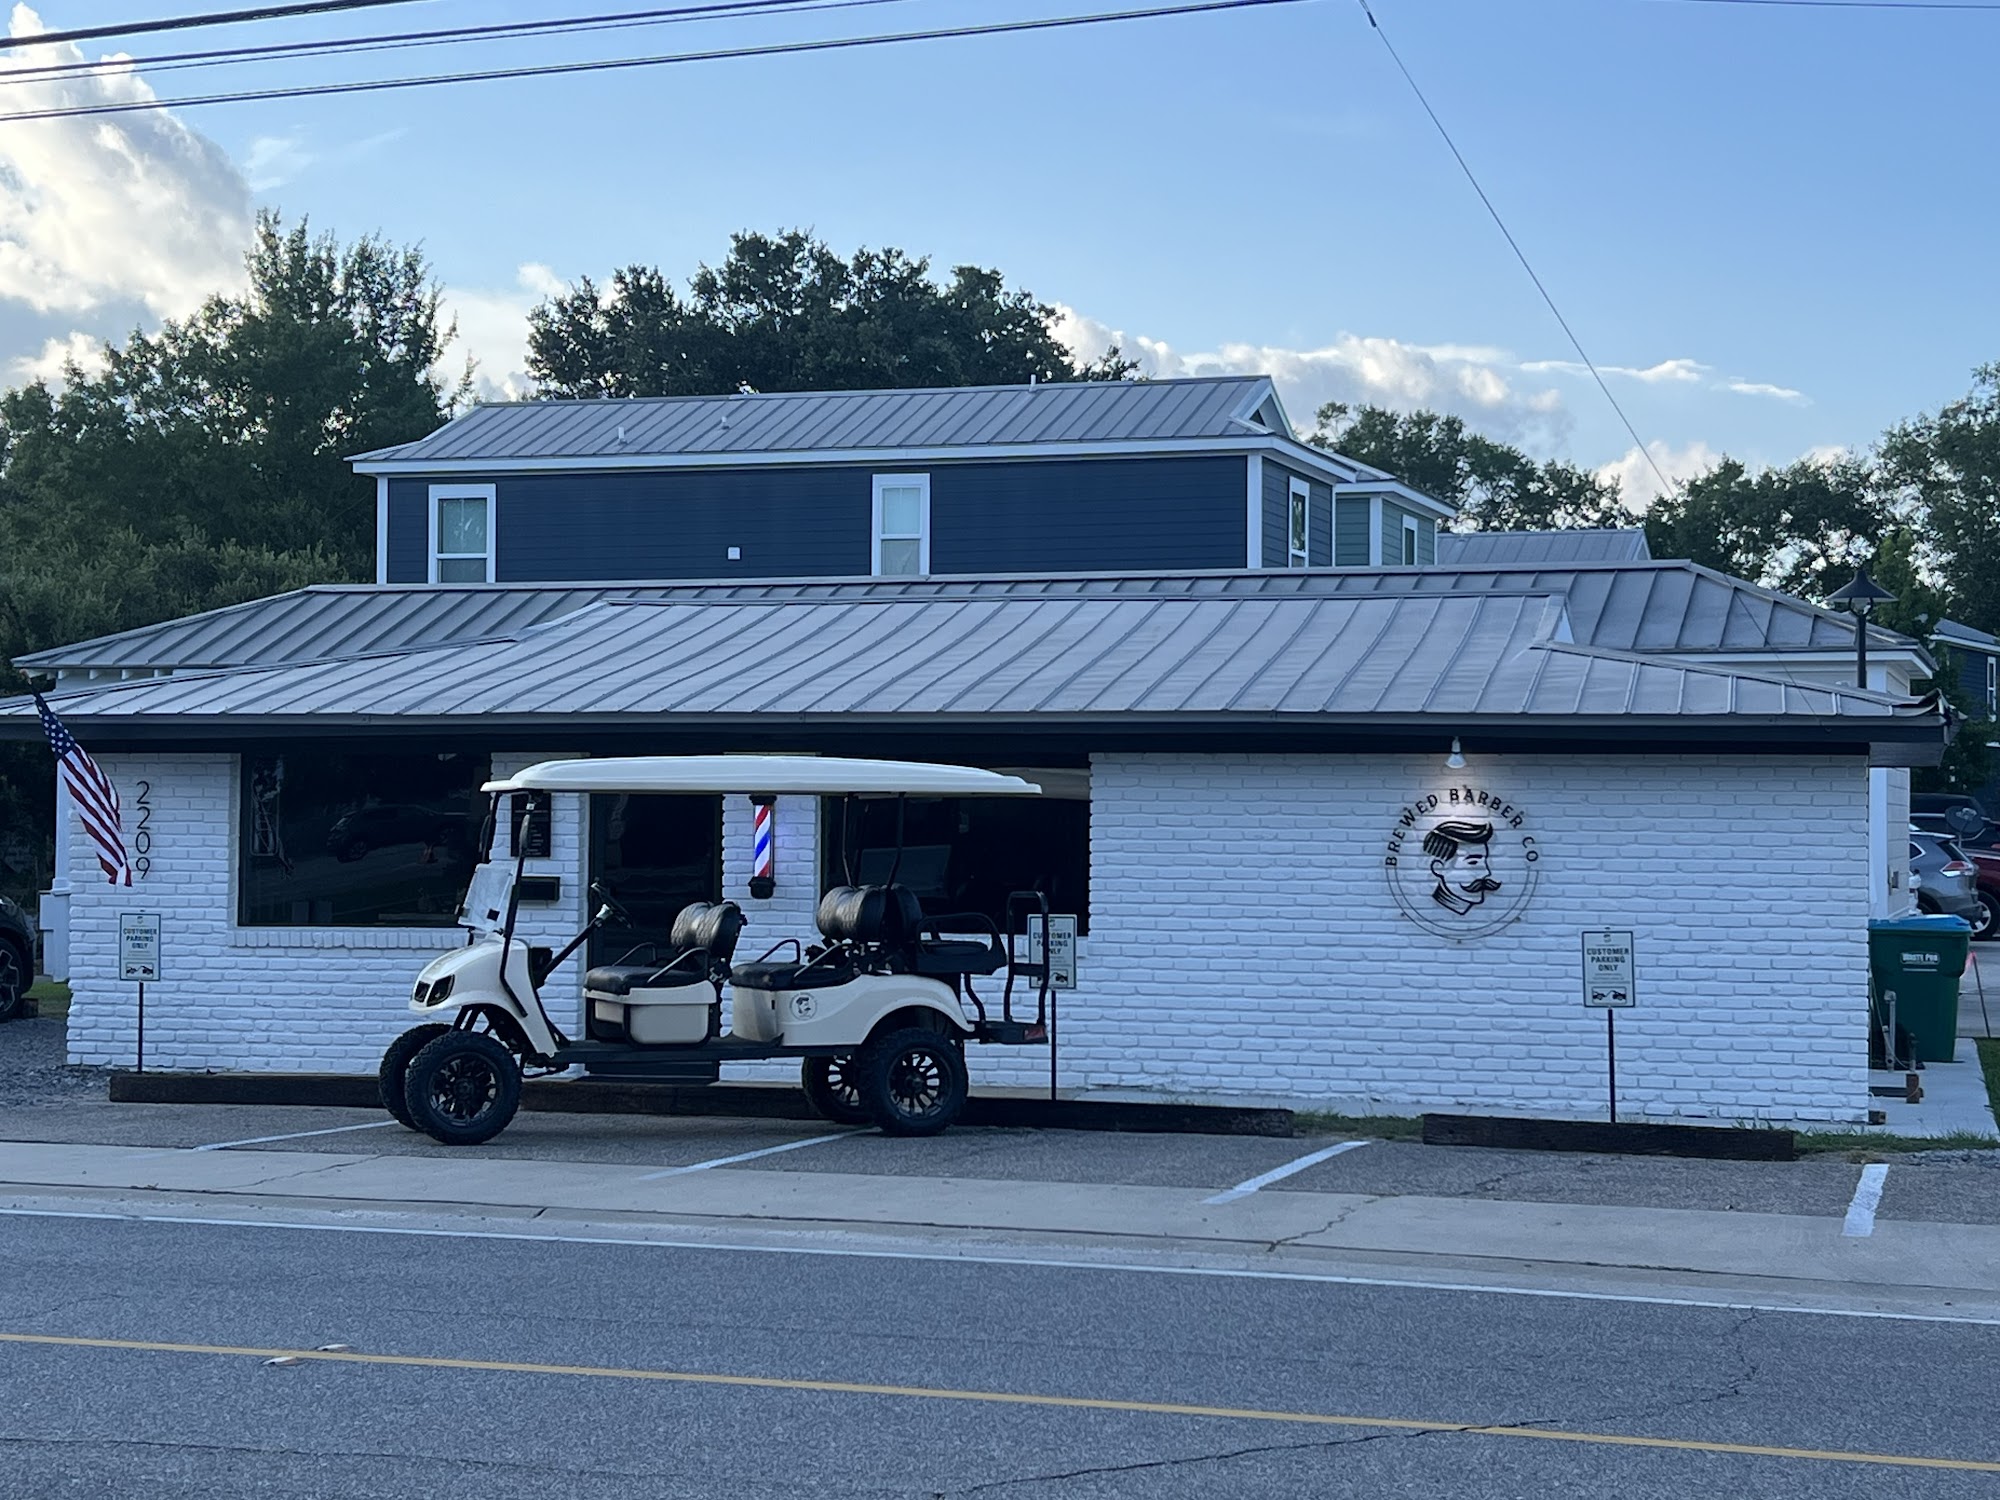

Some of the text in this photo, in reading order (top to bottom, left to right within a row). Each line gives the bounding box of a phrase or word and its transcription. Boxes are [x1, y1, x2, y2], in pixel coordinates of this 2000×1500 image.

[135, 780, 151, 880] 2209
[1385, 788, 1539, 867] BREWED BARBER CO
